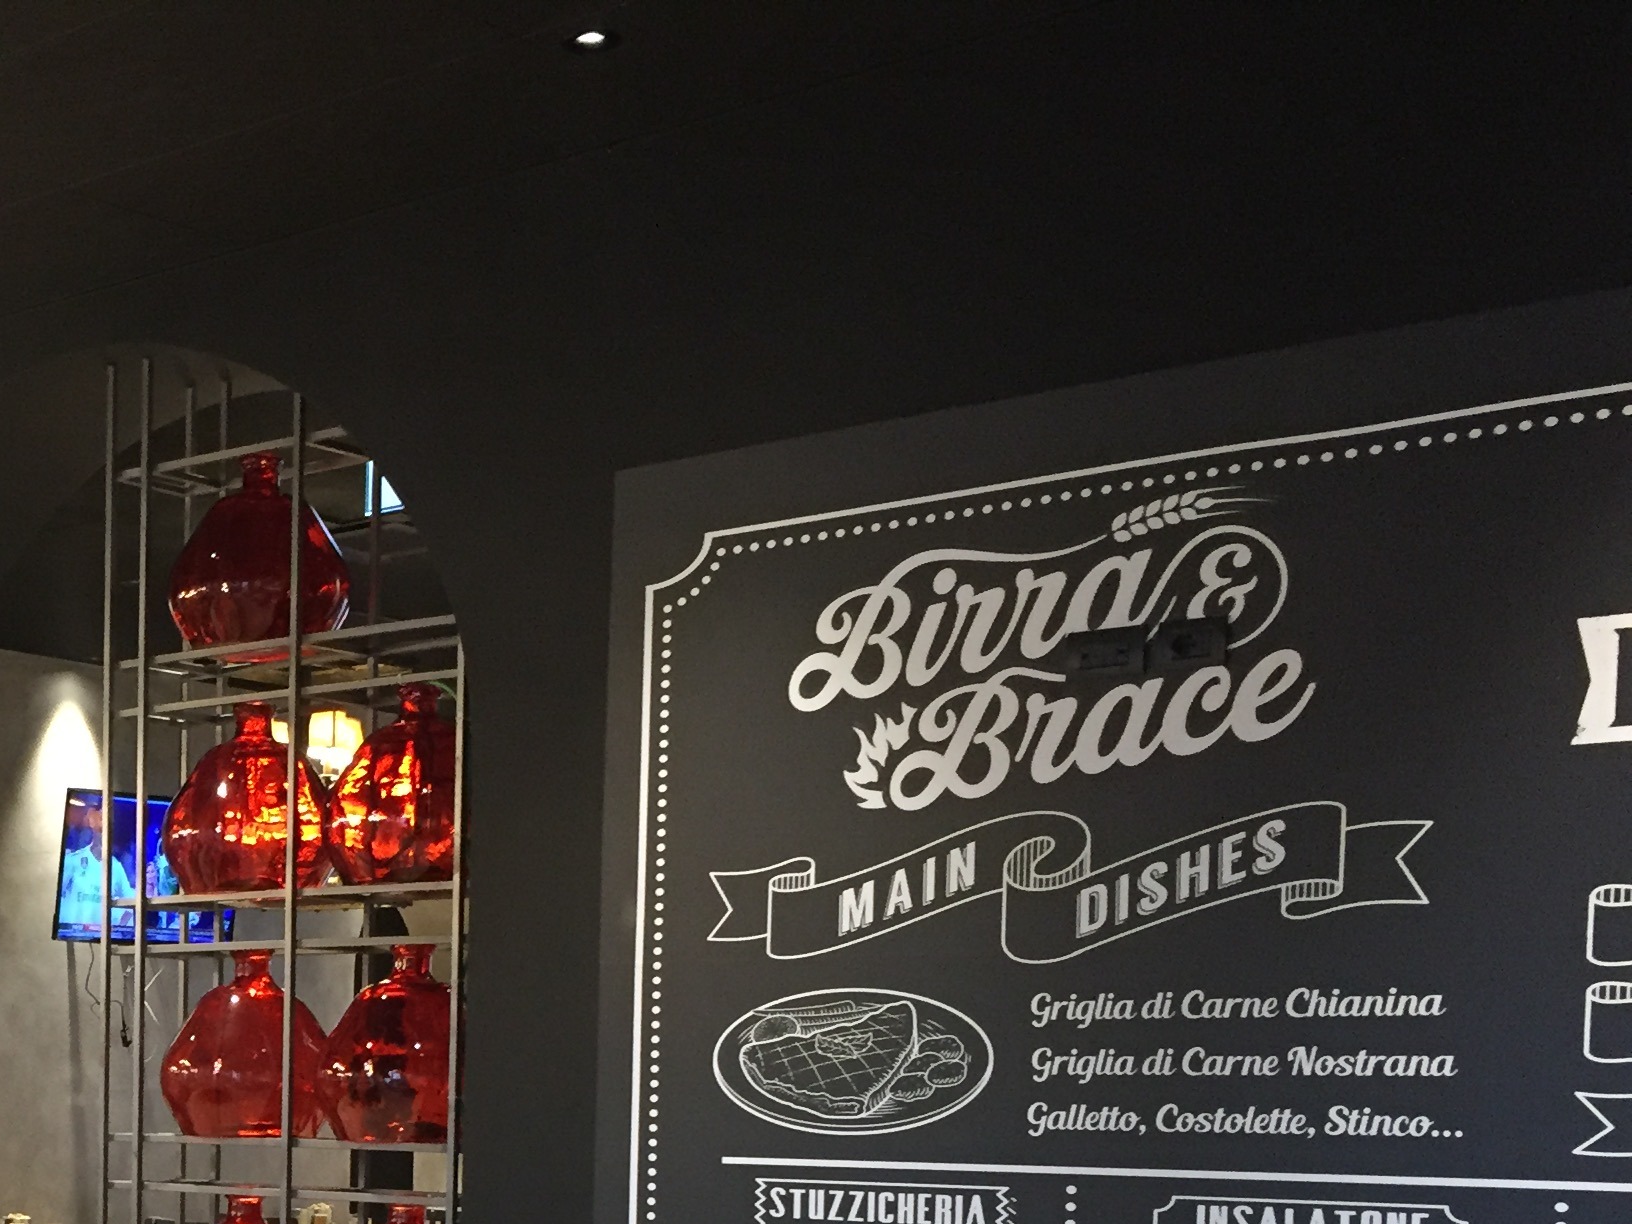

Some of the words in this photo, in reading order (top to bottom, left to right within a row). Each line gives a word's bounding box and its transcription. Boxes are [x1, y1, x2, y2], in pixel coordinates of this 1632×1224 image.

[789, 546, 1158, 711] Birra
[890, 649, 1318, 811] Brace
[836, 841, 977, 937] MAIN
[1074, 819, 1288, 939] DISHES
[1030, 992, 1137, 1028] Griglia
[1140, 991, 1176, 1020] di
[1180, 989, 1280, 1020] Carne
[1285, 987, 1447, 1018] Chianina
[1031, 1048, 1137, 1084] Griglia
[1141, 1047, 1177, 1076] di
[1181, 1046, 1280, 1077] Carne
[1287, 1045, 1459, 1077] Nostrana
[1026, 1101, 1148, 1137] Galletto,
[1155, 1103, 1317, 1139] Costolette,
[1324, 1105, 1464, 1138] Stinco...
